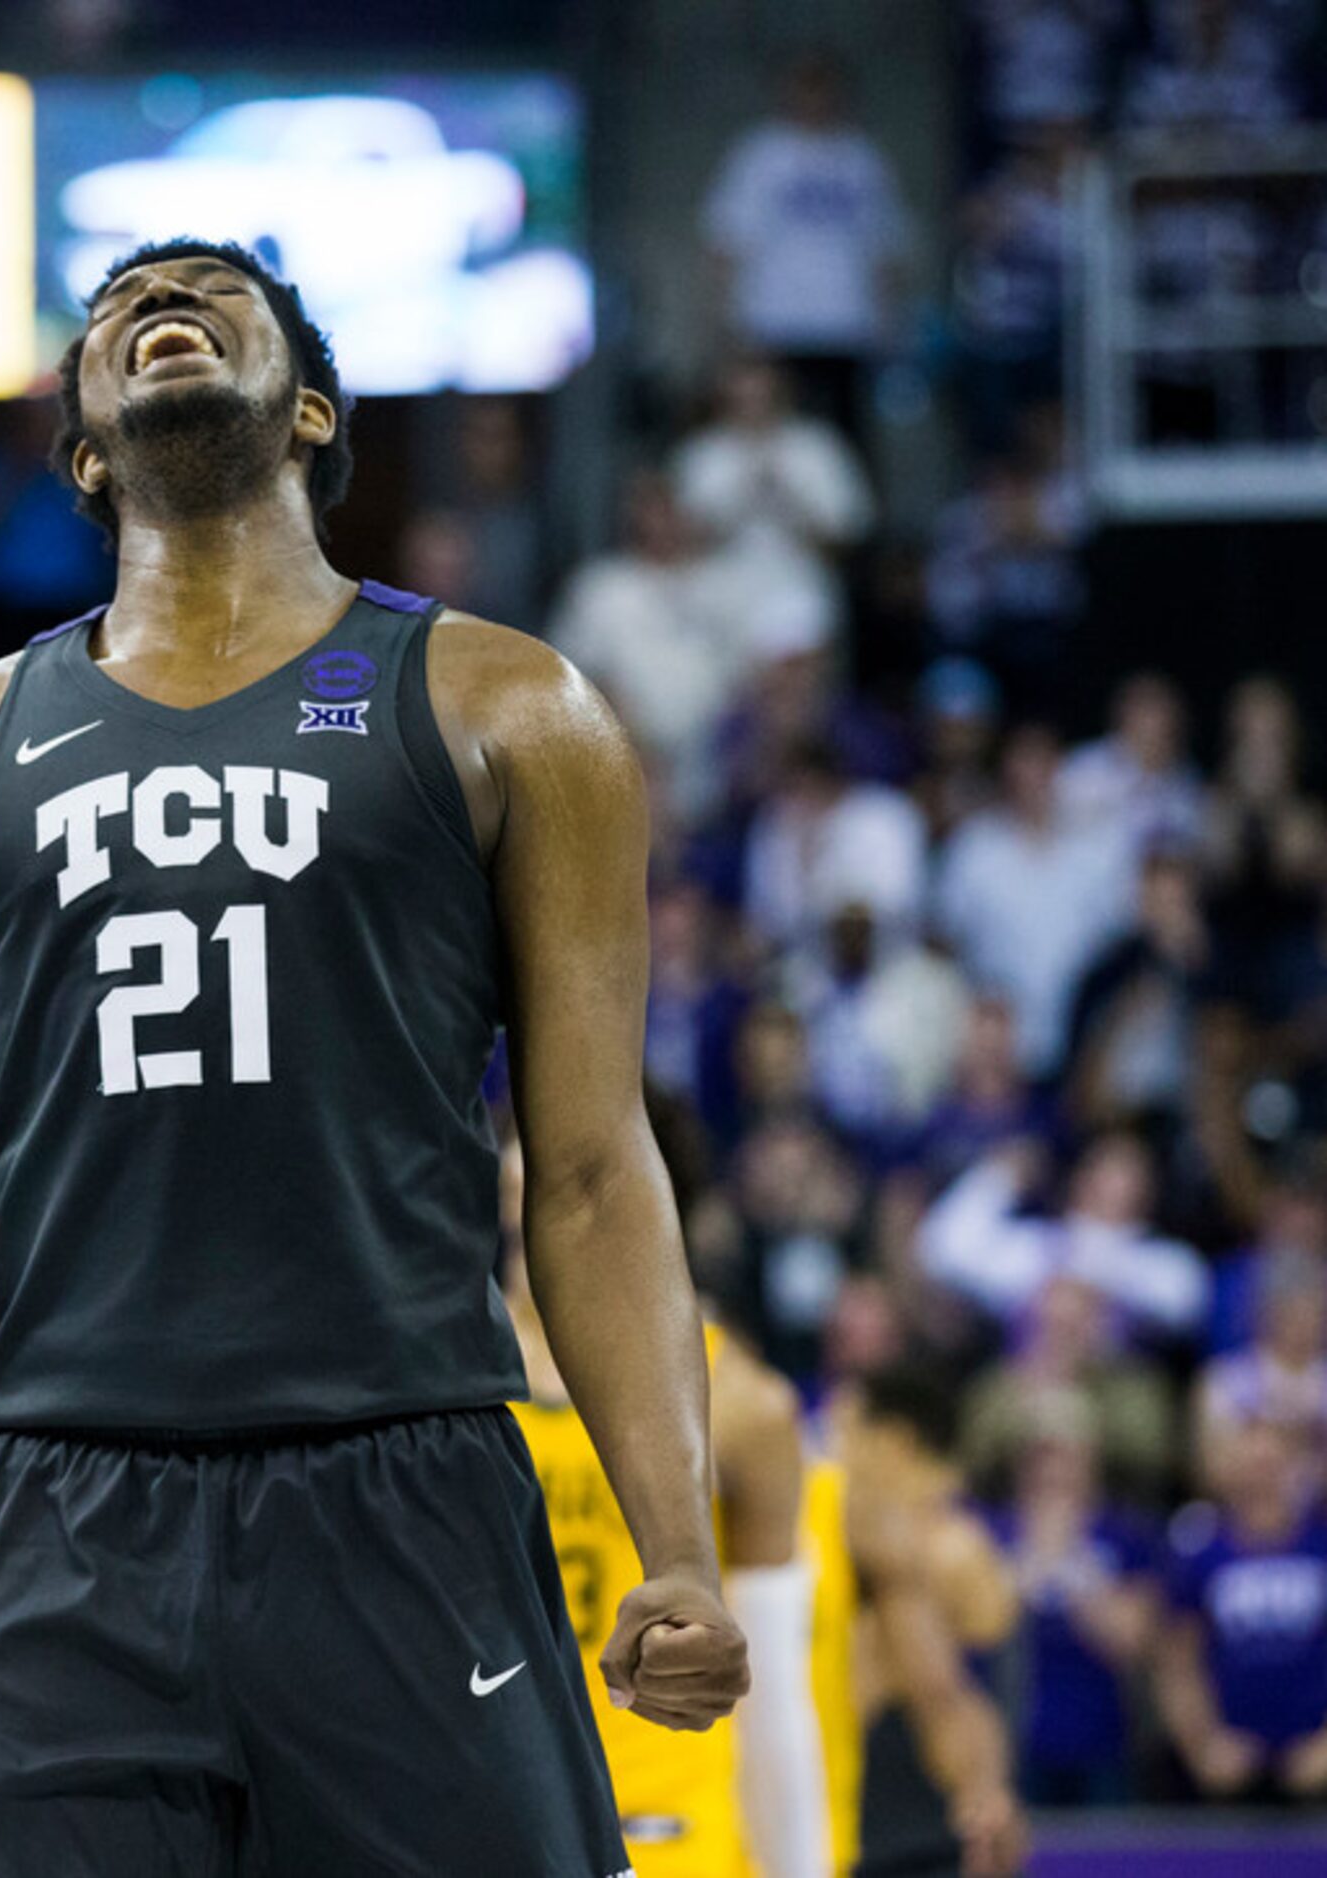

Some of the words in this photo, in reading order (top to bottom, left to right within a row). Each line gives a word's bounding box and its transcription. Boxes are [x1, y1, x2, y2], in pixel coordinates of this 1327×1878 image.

[299, 702, 368, 733] XII
[36, 765, 329, 909] TCU
[96, 904, 271, 1096] 21
